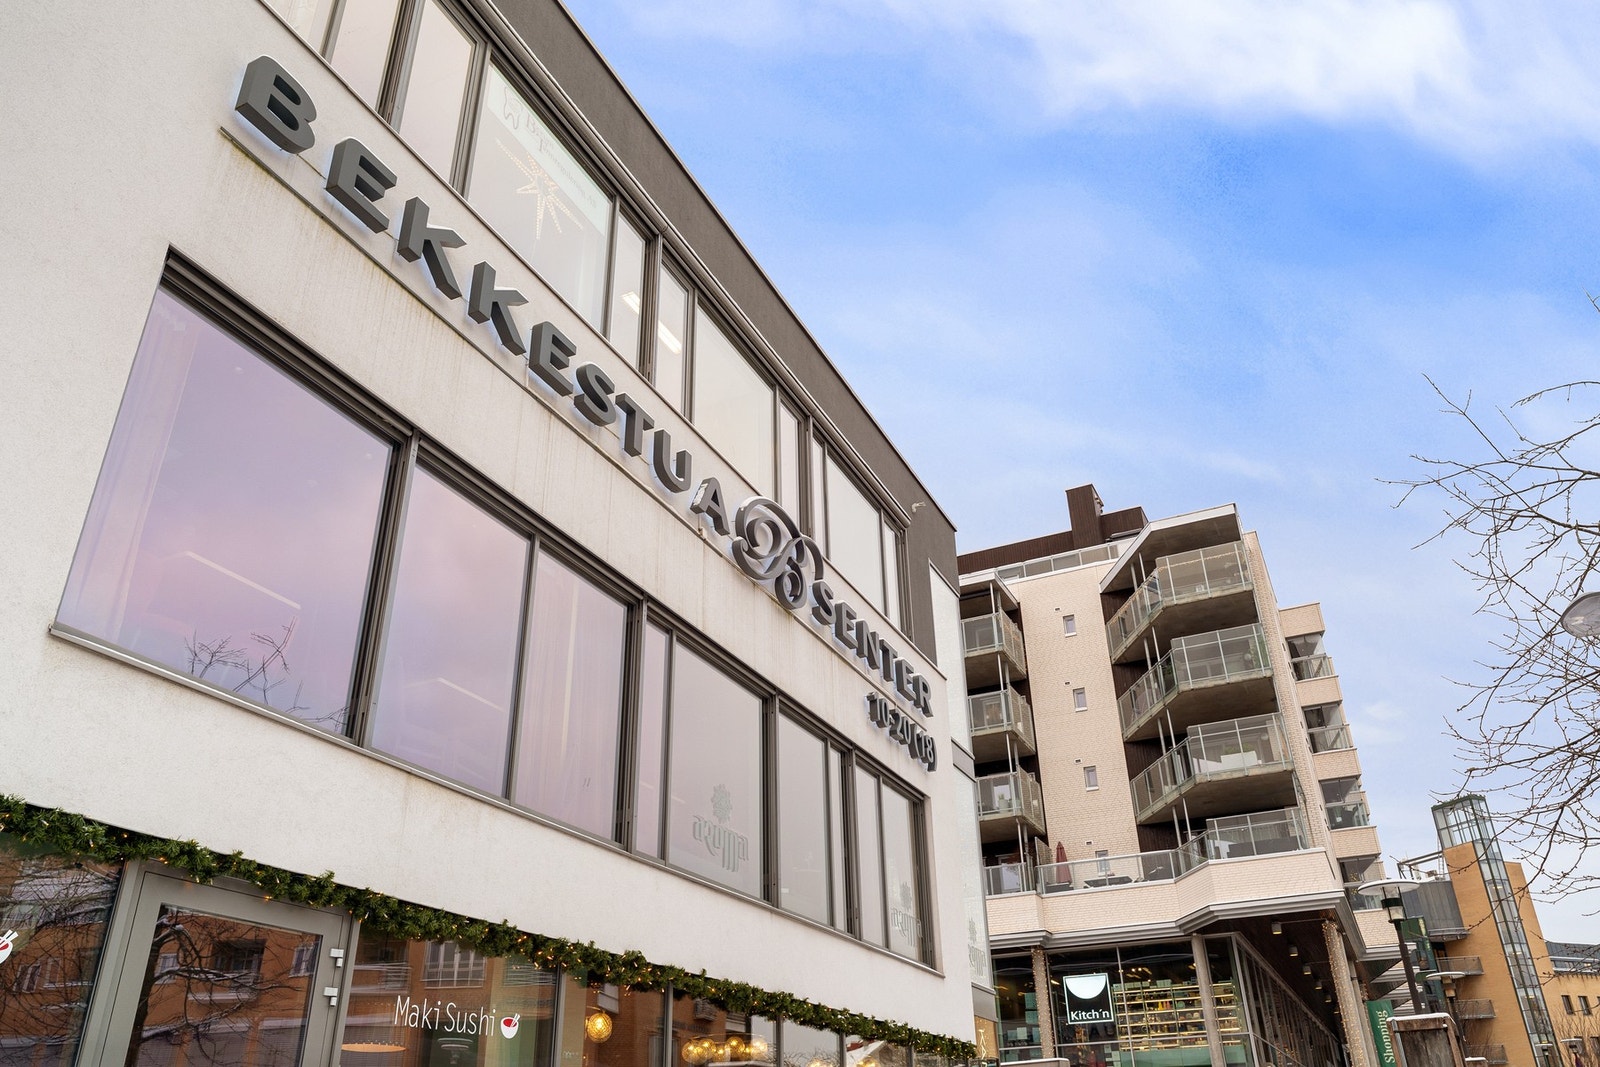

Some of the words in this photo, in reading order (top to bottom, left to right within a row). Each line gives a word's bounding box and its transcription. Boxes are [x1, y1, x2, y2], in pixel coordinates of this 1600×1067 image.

[235, 54, 730, 536] BEKKESTUA
[811, 578, 934, 718] SENTER
[866, 691, 938, 772] 10-20(18)
[394, 995, 441, 1031] Maki
[444, 1002, 497, 1037] Sushi
[1070, 1008, 1110, 1021] Kitch'n
[1375, 1009, 1396, 1064] Shopping
